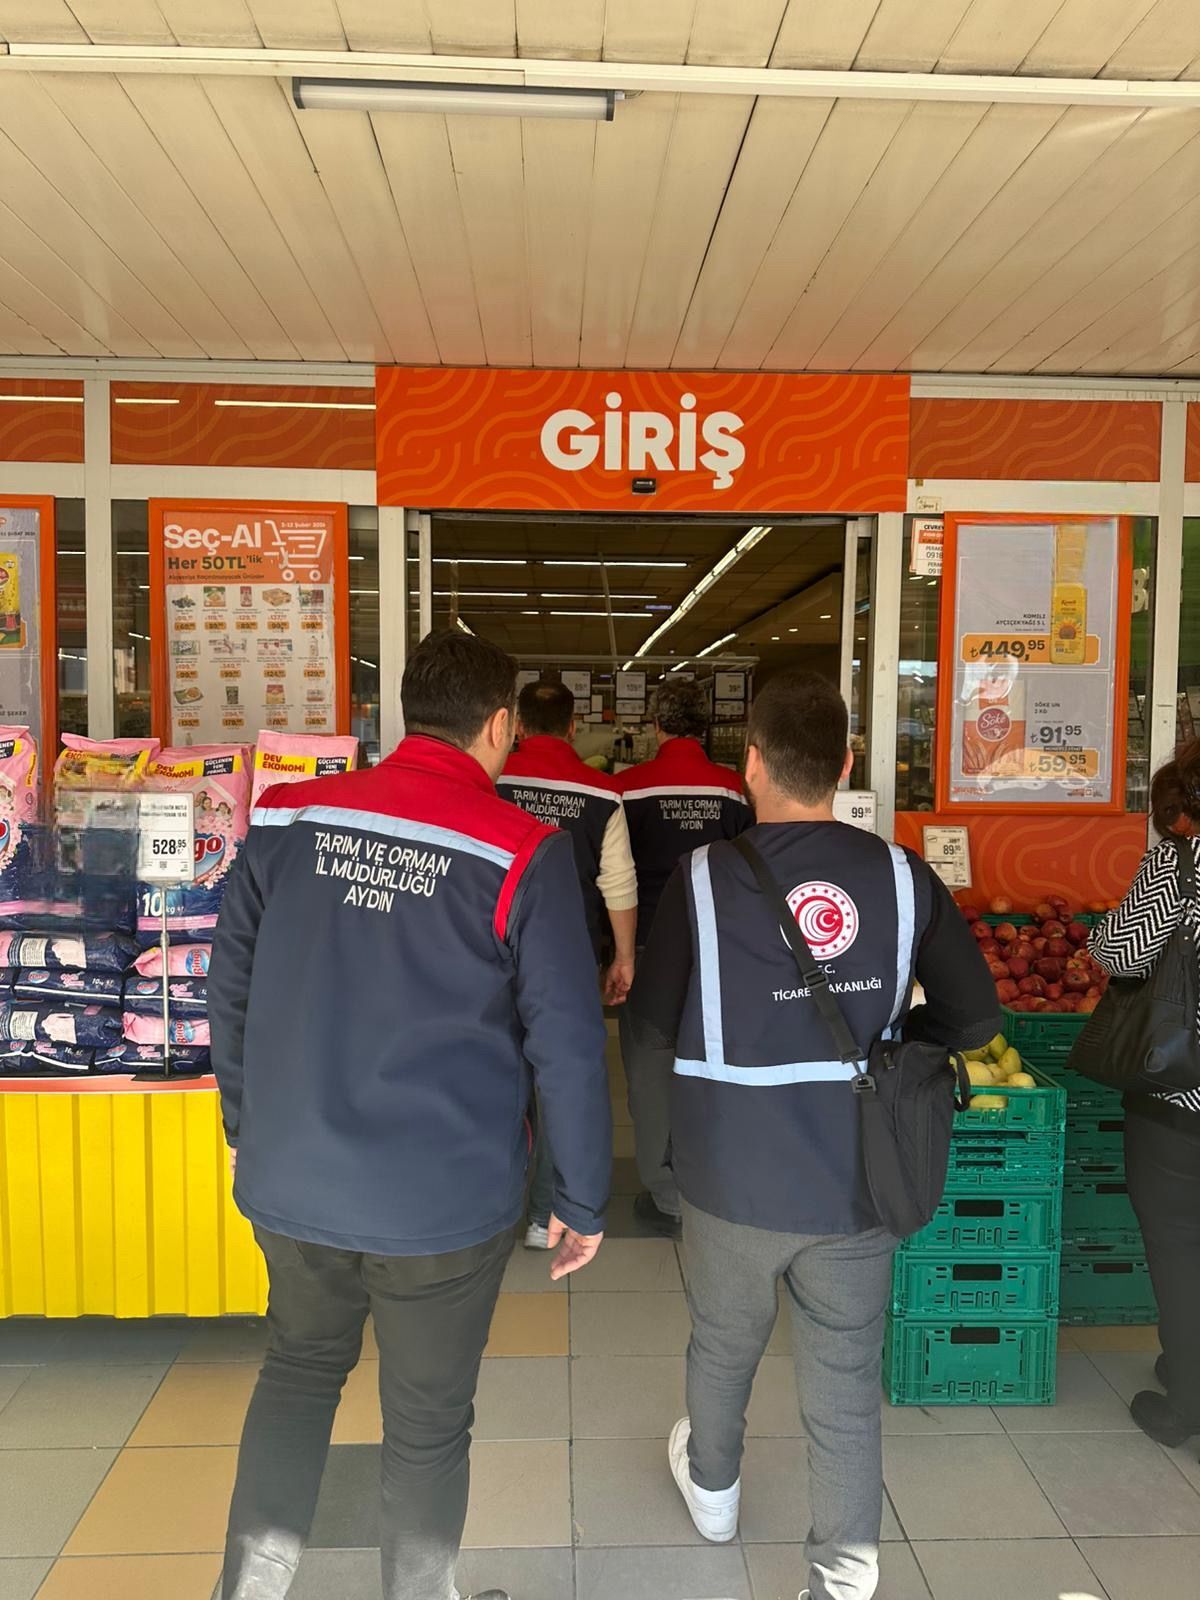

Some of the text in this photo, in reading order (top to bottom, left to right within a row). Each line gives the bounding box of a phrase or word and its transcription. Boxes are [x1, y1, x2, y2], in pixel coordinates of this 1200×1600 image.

[540, 392, 745, 489] GİRİŞ
[164, 522, 262, 556] Seç-Al
[168, 557, 197, 570] Her
[262, 761, 306, 773] EKONOMİ
[263, 753, 283, 762] DEV
[512, 790, 586, 808] TARIM VE ORMAN
[659, 799, 682, 809] TARIM
[682, 800, 694, 809] VE
[680, 820, 704, 830] AYDIN
[315, 832, 452, 876] TARIM VE ORMAN
[315, 851, 436, 897] İL MÜDÜRLÜĞÜ
[343, 885, 395, 913] AYDIN
[772, 977, 882, 1001] TİCARE AKANLIĞI
